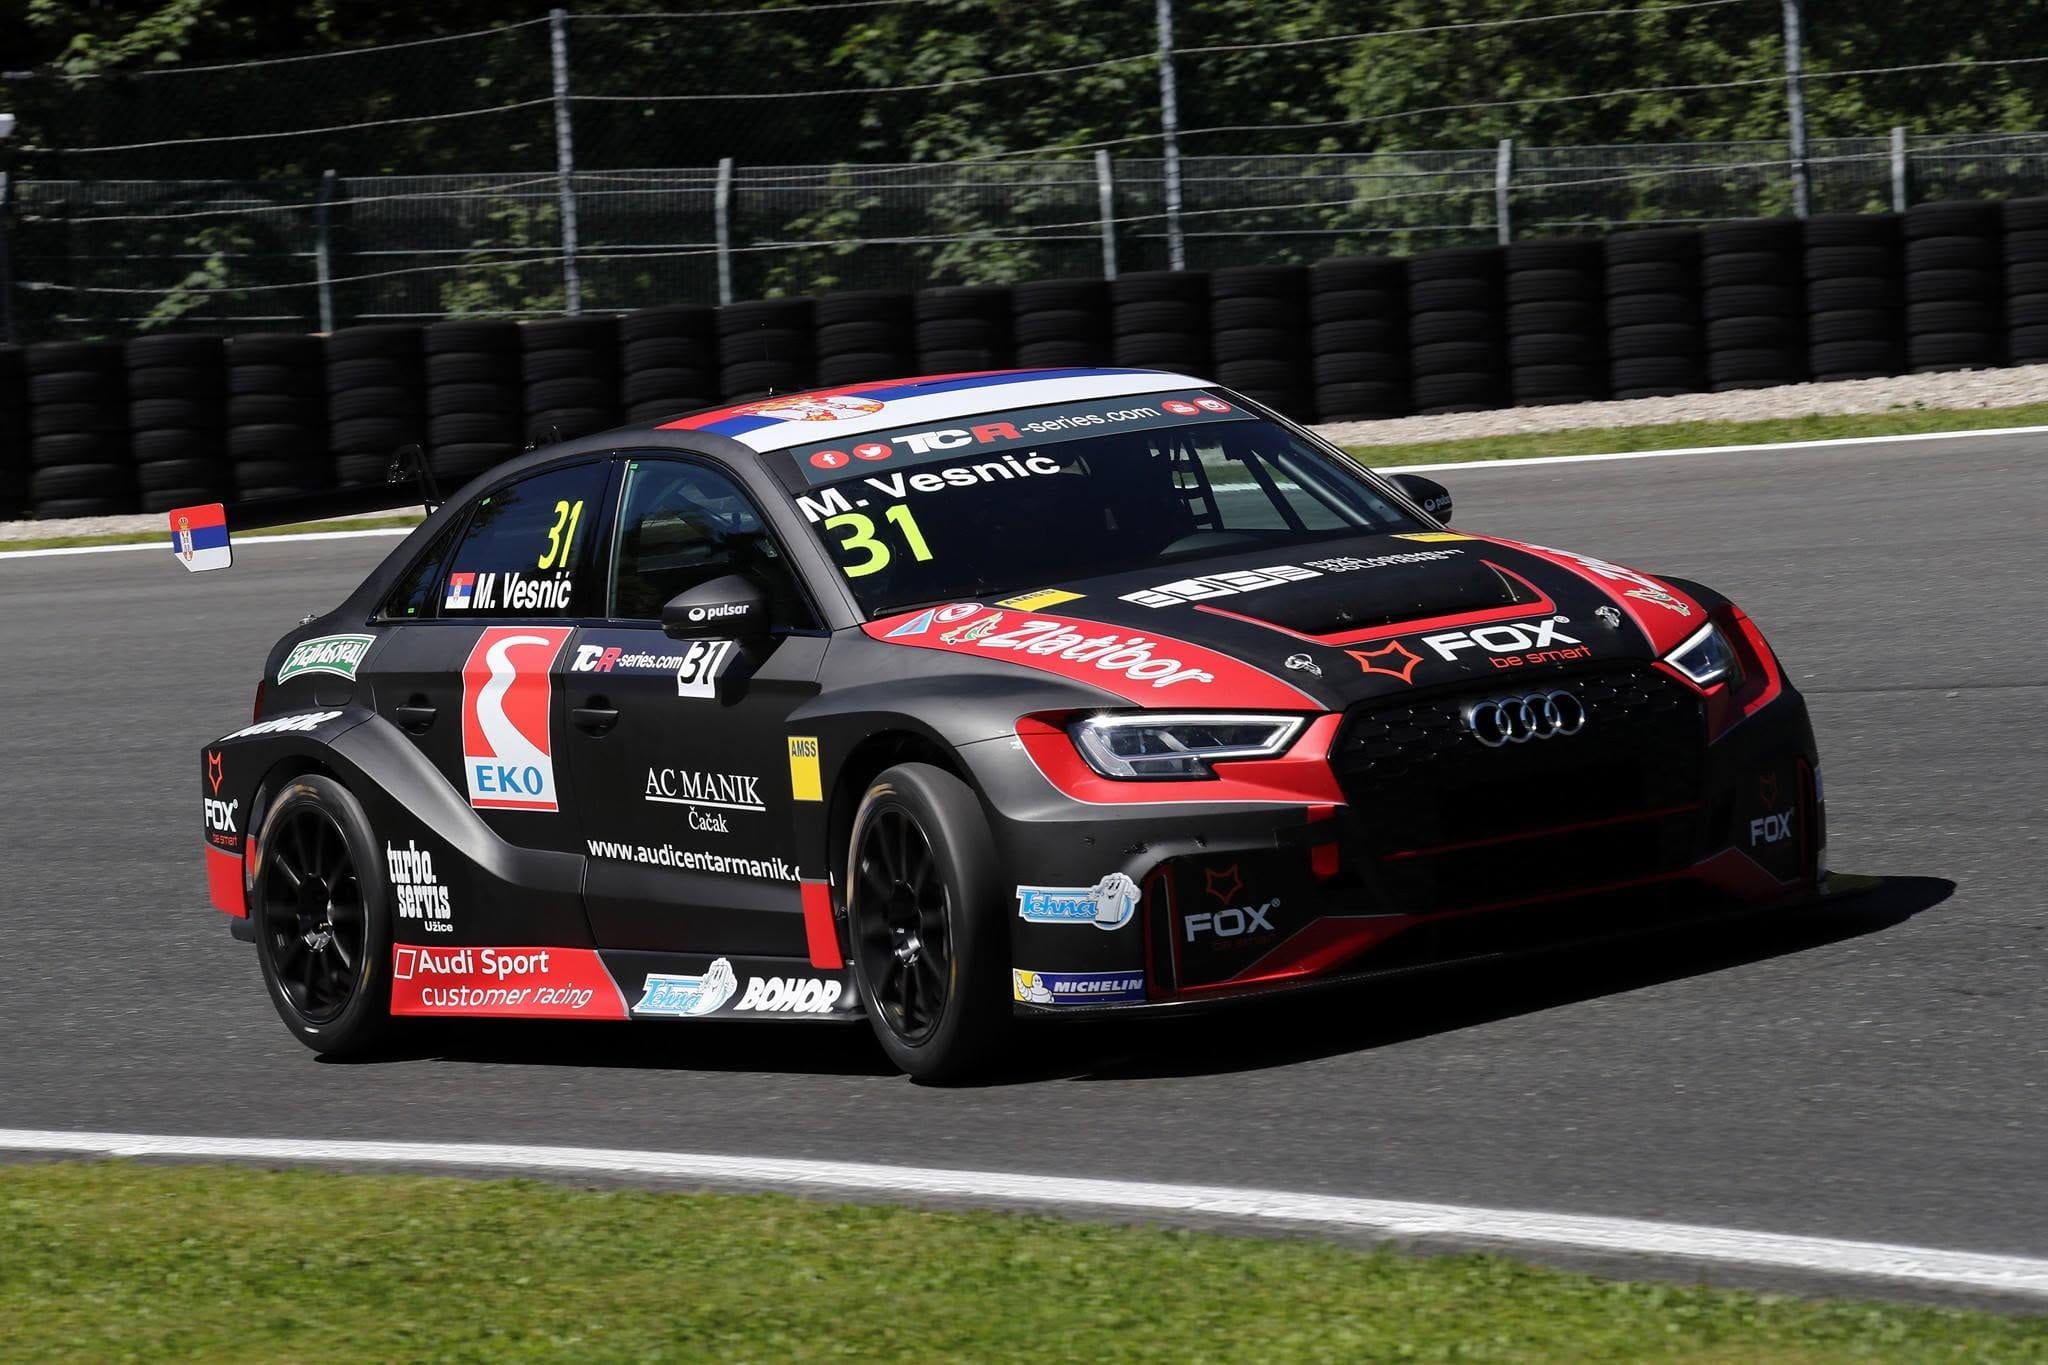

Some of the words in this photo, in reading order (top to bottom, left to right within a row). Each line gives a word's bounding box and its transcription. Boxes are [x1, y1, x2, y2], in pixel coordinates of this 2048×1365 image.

[891, 403, 1161, 455] TCR-series.com
[795, 488, 868, 524] M.
[864, 451, 1061, 499] Vesnić
[538, 500, 583, 570] 31
[824, 503, 934, 579] 31
[473, 572, 496, 609] M.
[503, 571, 572, 609] Vesnić
[707, 603, 749, 621] pulsar
[976, 620, 1214, 688] Zlatibor
[1421, 619, 1582, 662] FOX
[1489, 655, 1522, 669] be
[1525, 645, 1592, 664] smart
[571, 644, 682, 673] TCR-series.com
[680, 642, 727, 684] 31
[791, 740, 817, 758] AMSS
[475, 765, 544, 796] EKO
[645, 767, 677, 797] AC
[679, 770, 764, 805] MANIK
[204, 798, 237, 833] FOX
[688, 806, 729, 833] Čačak
[1750, 811, 1792, 847] FOX
[397, 885, 451, 919] servis
[1022, 890, 1098, 917] Tehna
[424, 921, 453, 932] Užice
[1184, 903, 1275, 943] FOX
[418, 949, 474, 975] Audi
[480, 949, 549, 981] Sport
[421, 985, 531, 1007] customer
[533, 982, 594, 1009] racing
[1053, 979, 1144, 993] MICHELIN
